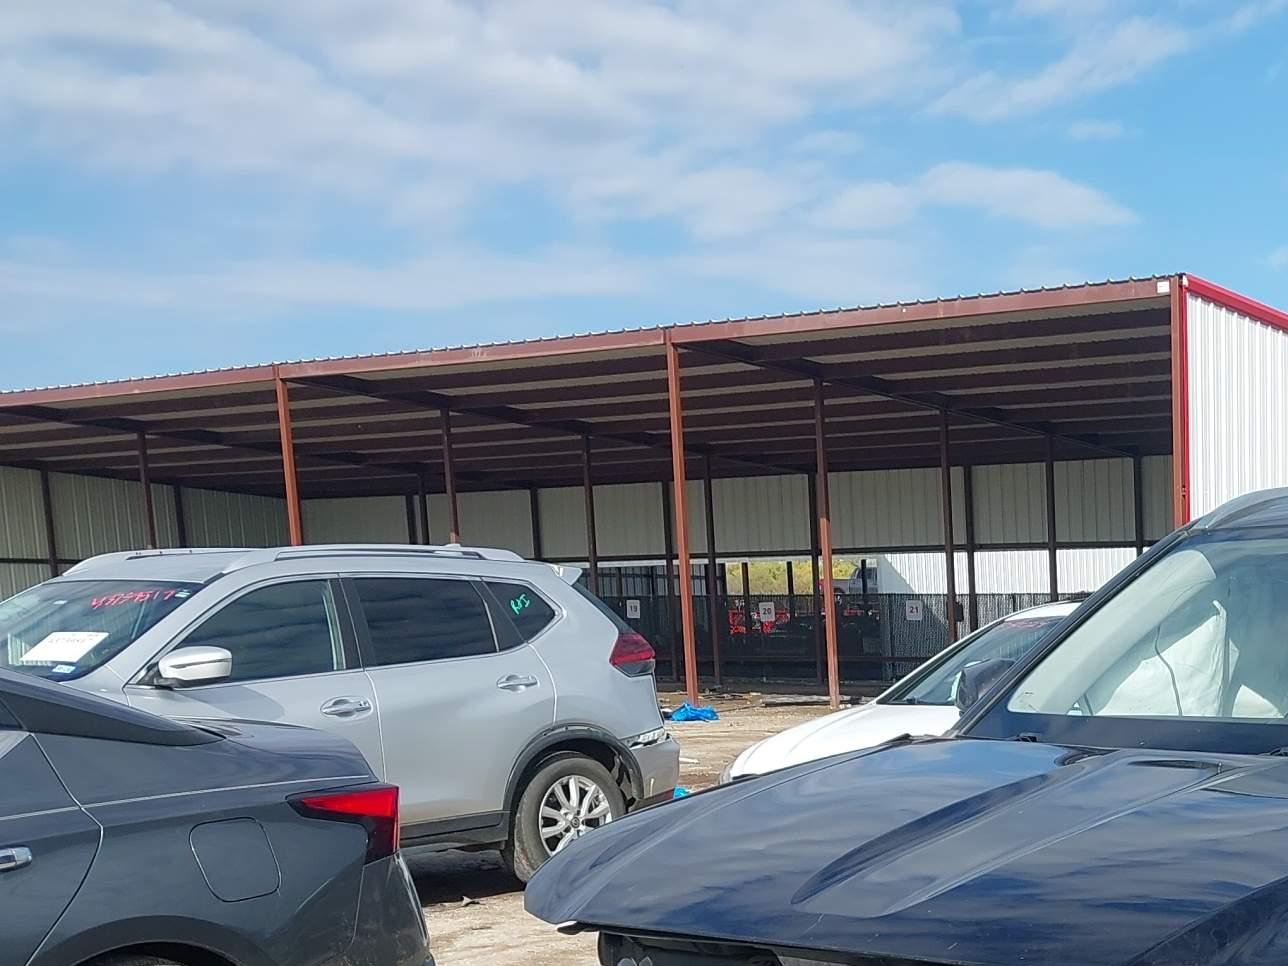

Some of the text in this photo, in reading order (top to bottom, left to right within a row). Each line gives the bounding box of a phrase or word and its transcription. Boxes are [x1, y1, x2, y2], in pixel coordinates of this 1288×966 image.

[629, 604, 638, 613] 19
[762, 606, 772, 615] 20
[909, 606, 919, 614] 21
